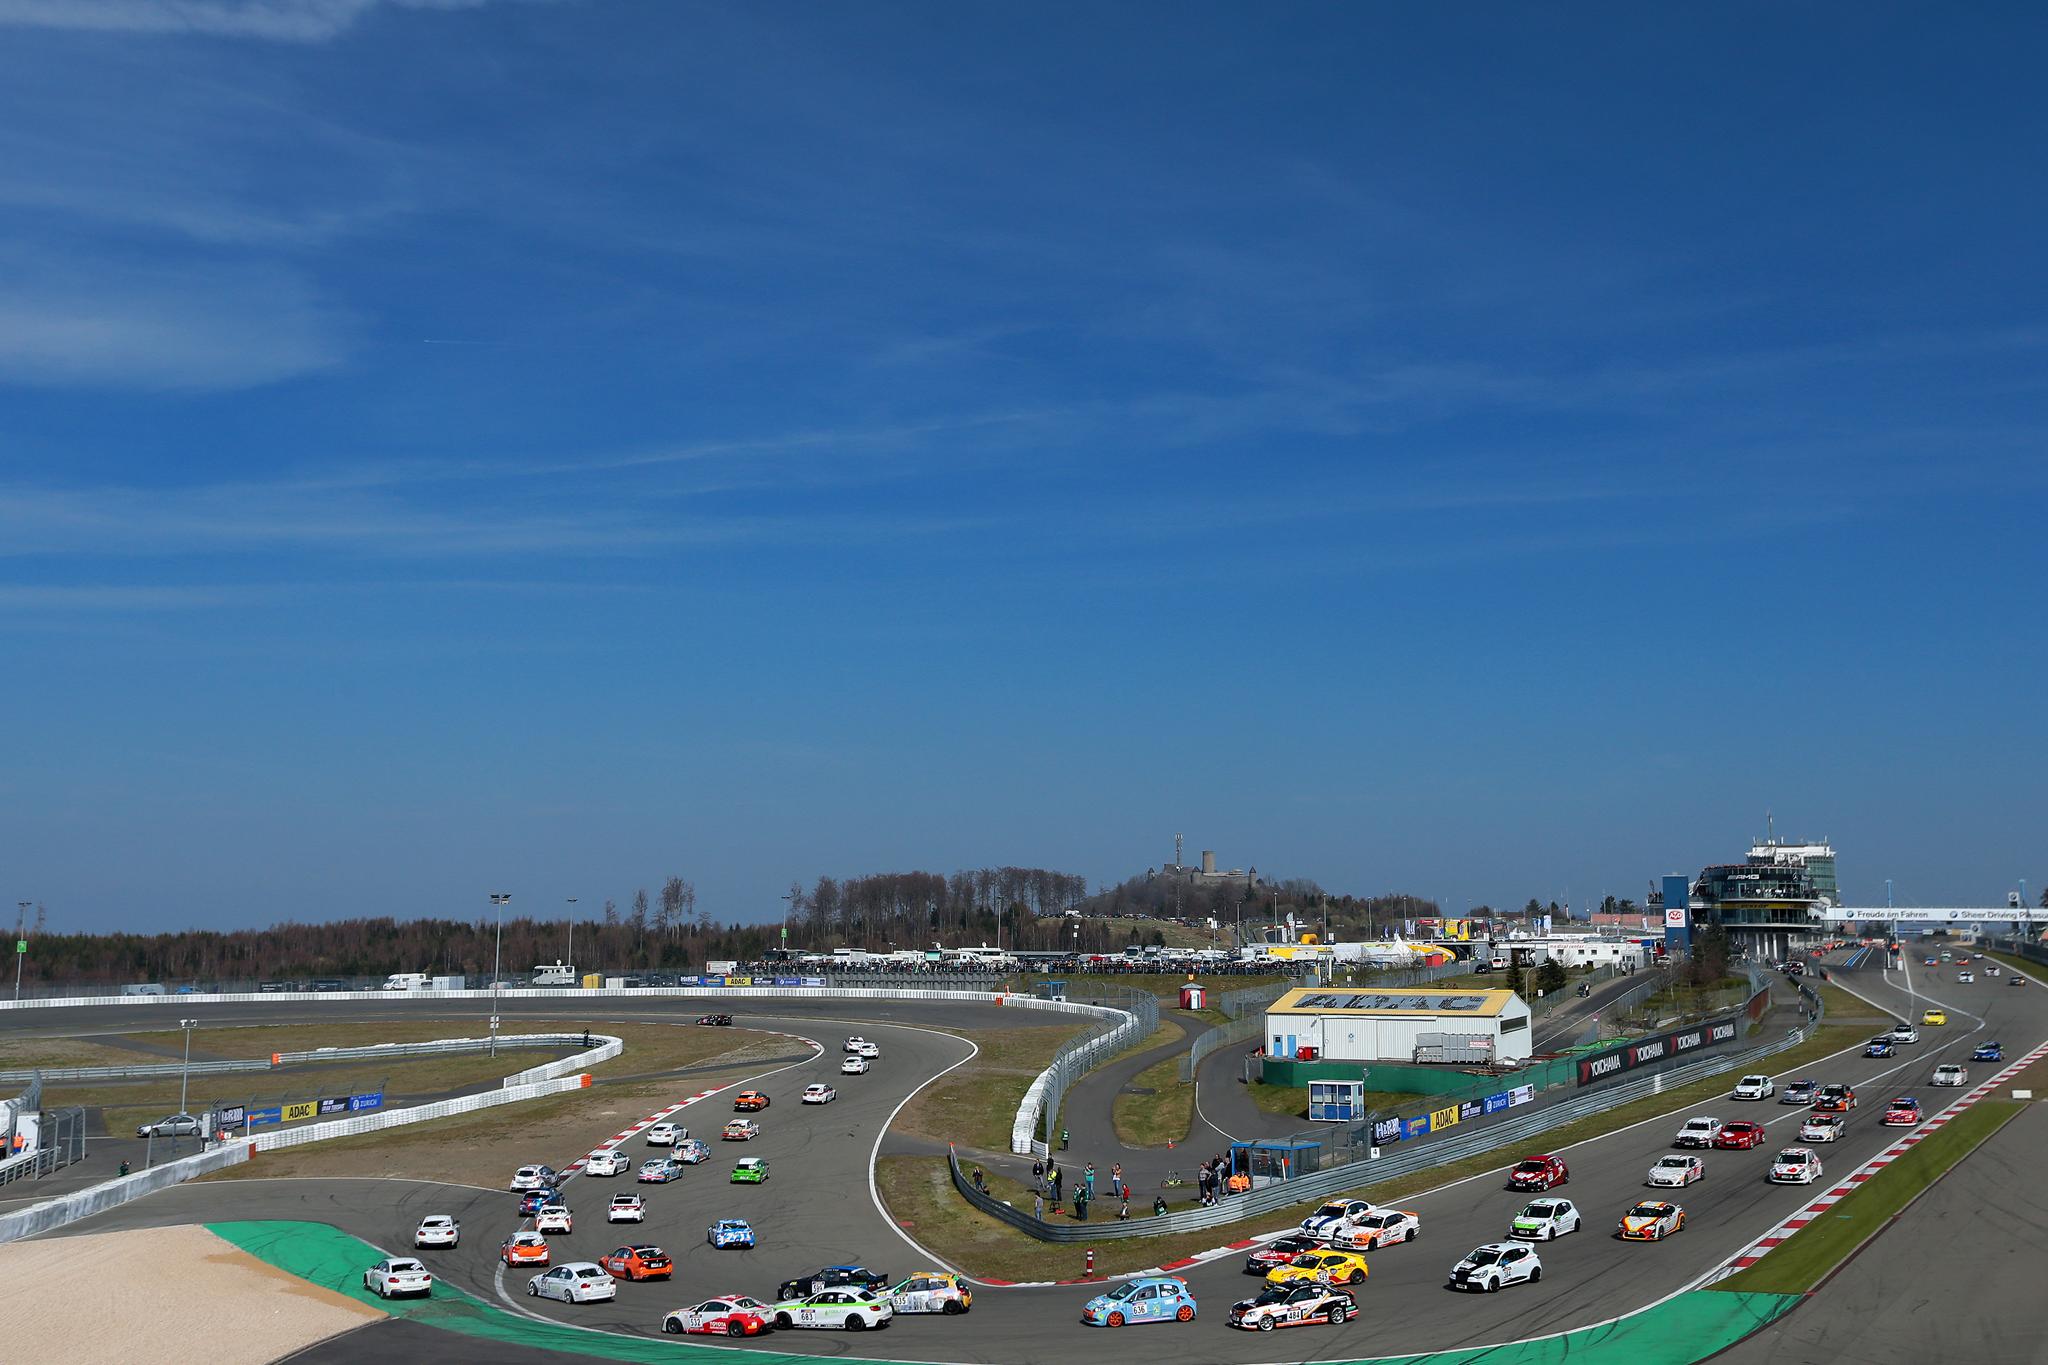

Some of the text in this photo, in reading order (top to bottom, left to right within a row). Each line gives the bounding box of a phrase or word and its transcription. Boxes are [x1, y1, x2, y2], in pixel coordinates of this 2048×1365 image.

[1987, 911, 2017, 920] Driving
[1712, 1023, 1734, 1040] YOKOHAMA
[1677, 1032, 1701, 1050] YOKOHAMA
[1636, 1041, 1664, 1062] YOKOHAMA
[1590, 1054, 1621, 1077] YOKOHAMA
[289, 1105, 310, 1118] ADAC
[1436, 1108, 1454, 1128] ADAC
[801, 1312, 813, 1321] 683
[1133, 1305, 1146, 1315] 636
[1288, 1310, 1300, 1319] 484
[690, 1318, 701, 1326] 532
